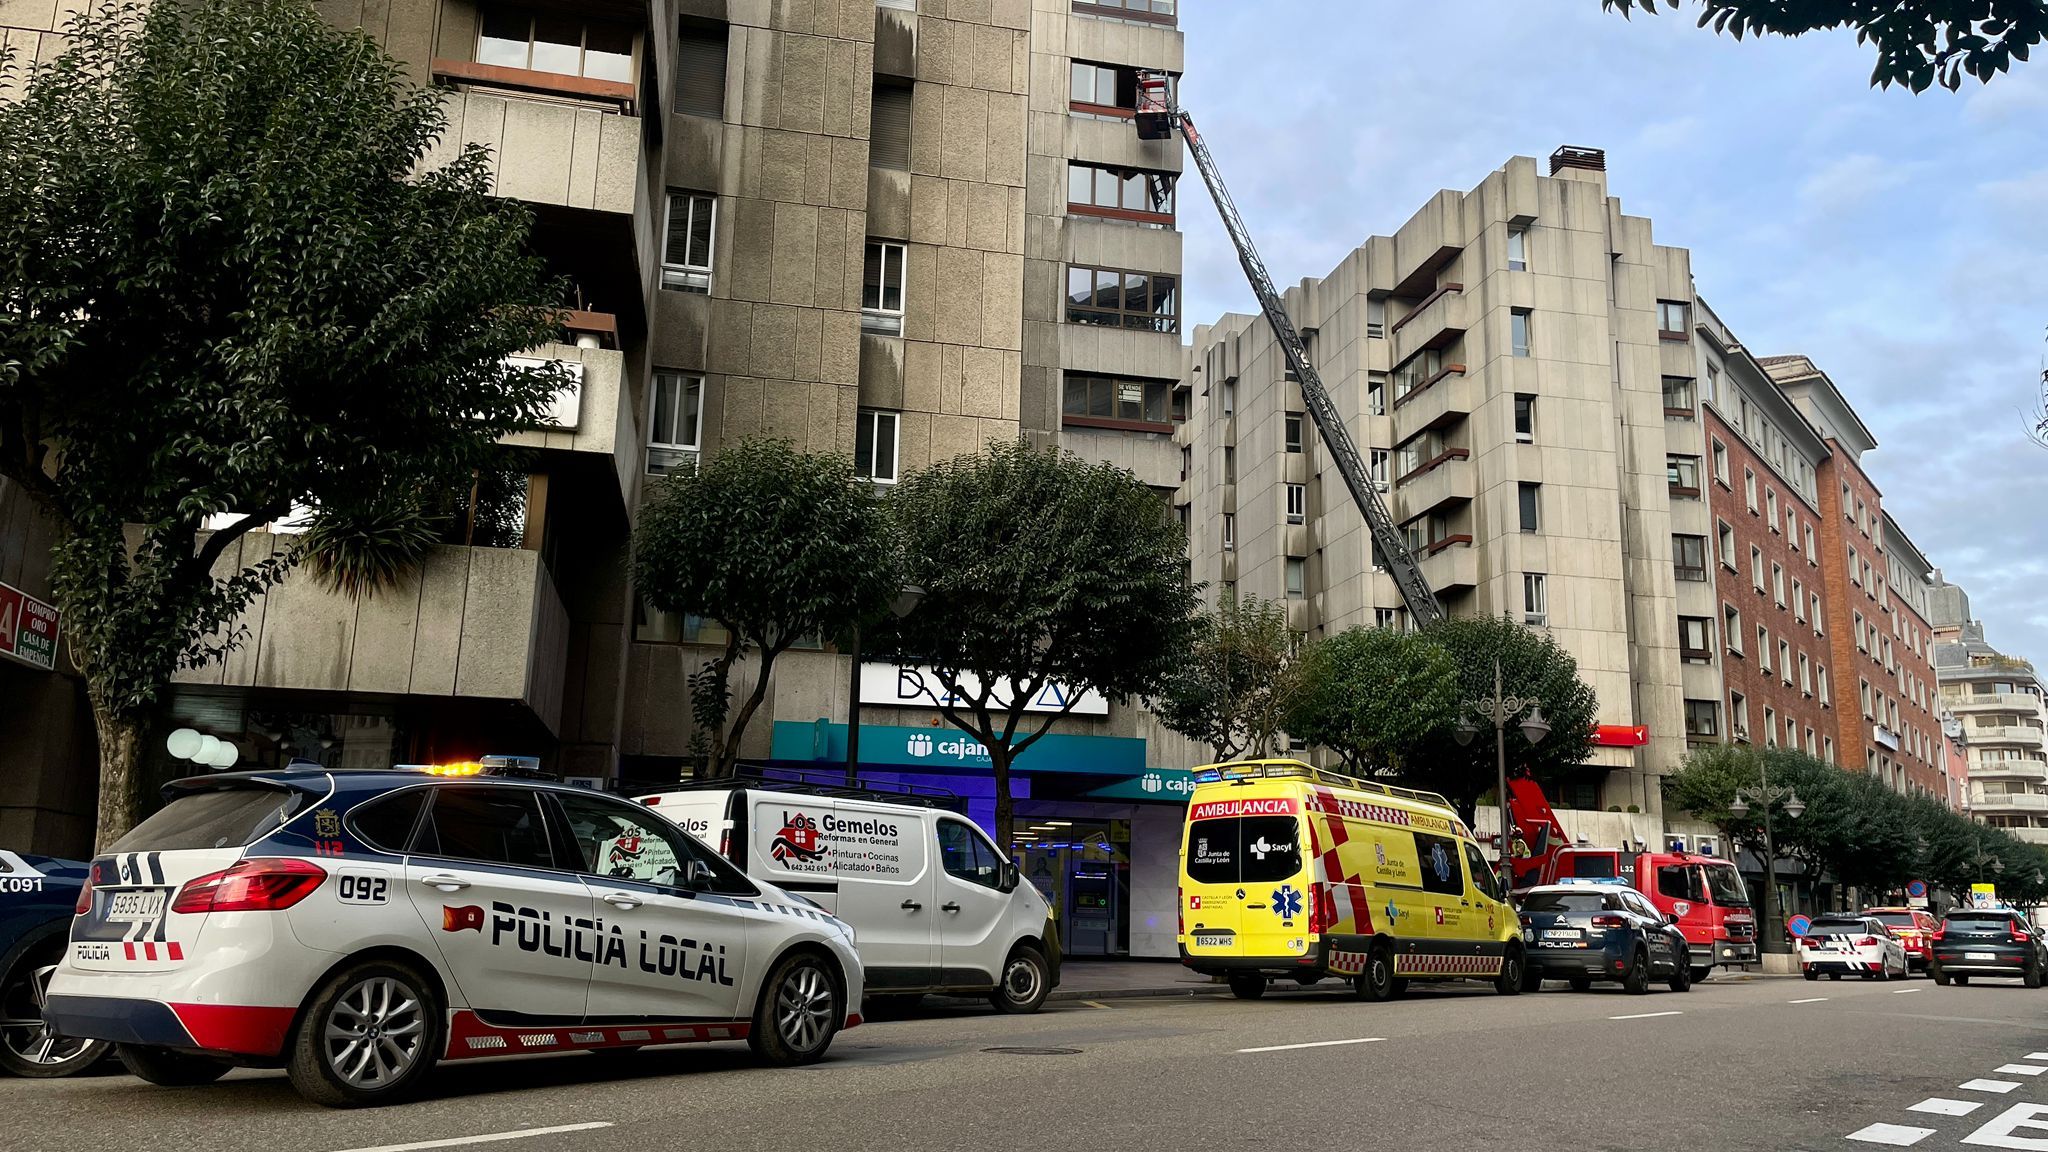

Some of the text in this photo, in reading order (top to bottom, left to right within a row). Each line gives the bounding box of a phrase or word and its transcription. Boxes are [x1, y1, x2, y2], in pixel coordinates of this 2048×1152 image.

[27, 601, 56, 622] COMPRO
[31, 618, 47, 633] ORO
[23, 631, 50, 651] CASA DE
[20, 646, 50, 666] EMPEÑOS
[1195, 800, 1290, 818] AMBULANCIA
[783, 811, 898, 838] Los Gemelos
[1410, 815, 1449, 830] AMBULANCIA
[818, 832, 899, 846] Reformas en General
[316, 840, 344, 856] 112
[1222, 850, 1230, 858] de
[1272, 842, 1292, 853] Sacyl
[832, 849, 899, 862] Pintura Cocinas
[832, 861, 900, 874] Alicatado Baños
[1620, 865, 1634, 873] L32
[10, 878, 43, 893] 091
[340, 876, 387, 902] 092
[113, 895, 164, 915] 5935 LVX
[1200, 937, 1233, 946] 6522 MHS
[1538, 941, 1579, 949] POLICIA
[640, 929, 734, 987] LOCAL
